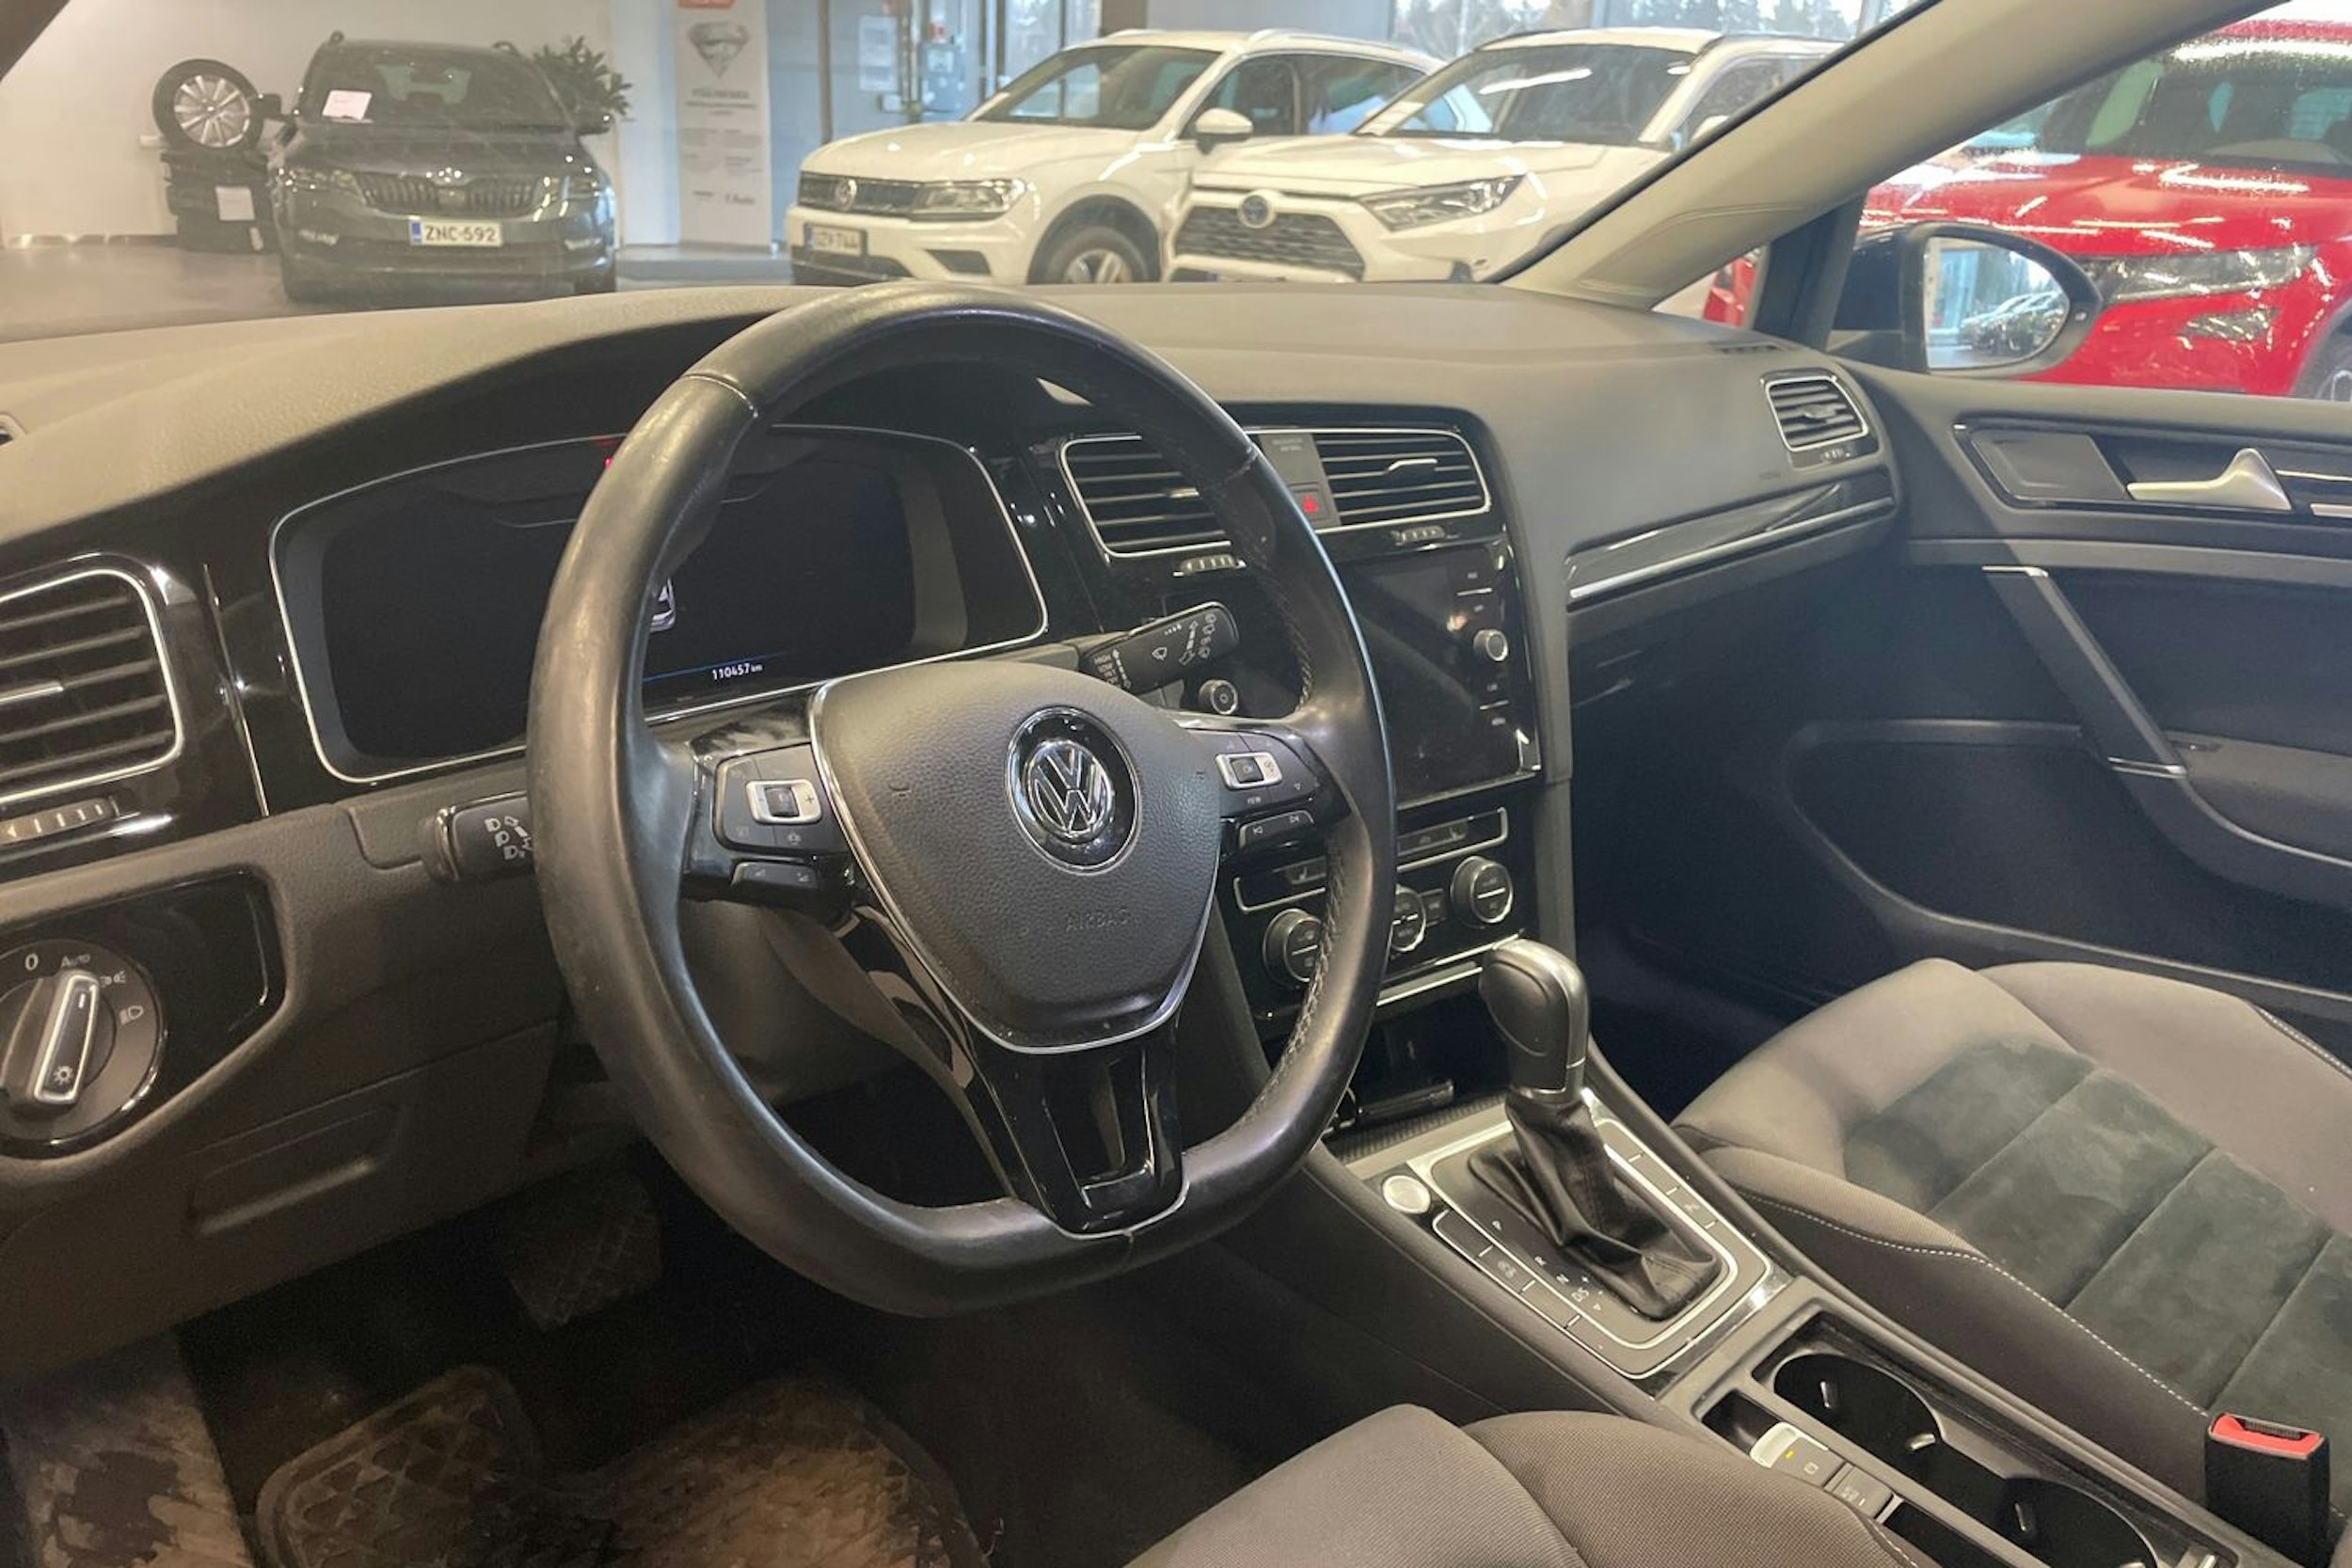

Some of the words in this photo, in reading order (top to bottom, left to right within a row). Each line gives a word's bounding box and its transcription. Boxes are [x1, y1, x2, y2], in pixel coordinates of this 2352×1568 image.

[425, 225, 497, 243] ZNC-592
[712, 662, 751, 680] 110457
[24, 953, 39, 971] 0
